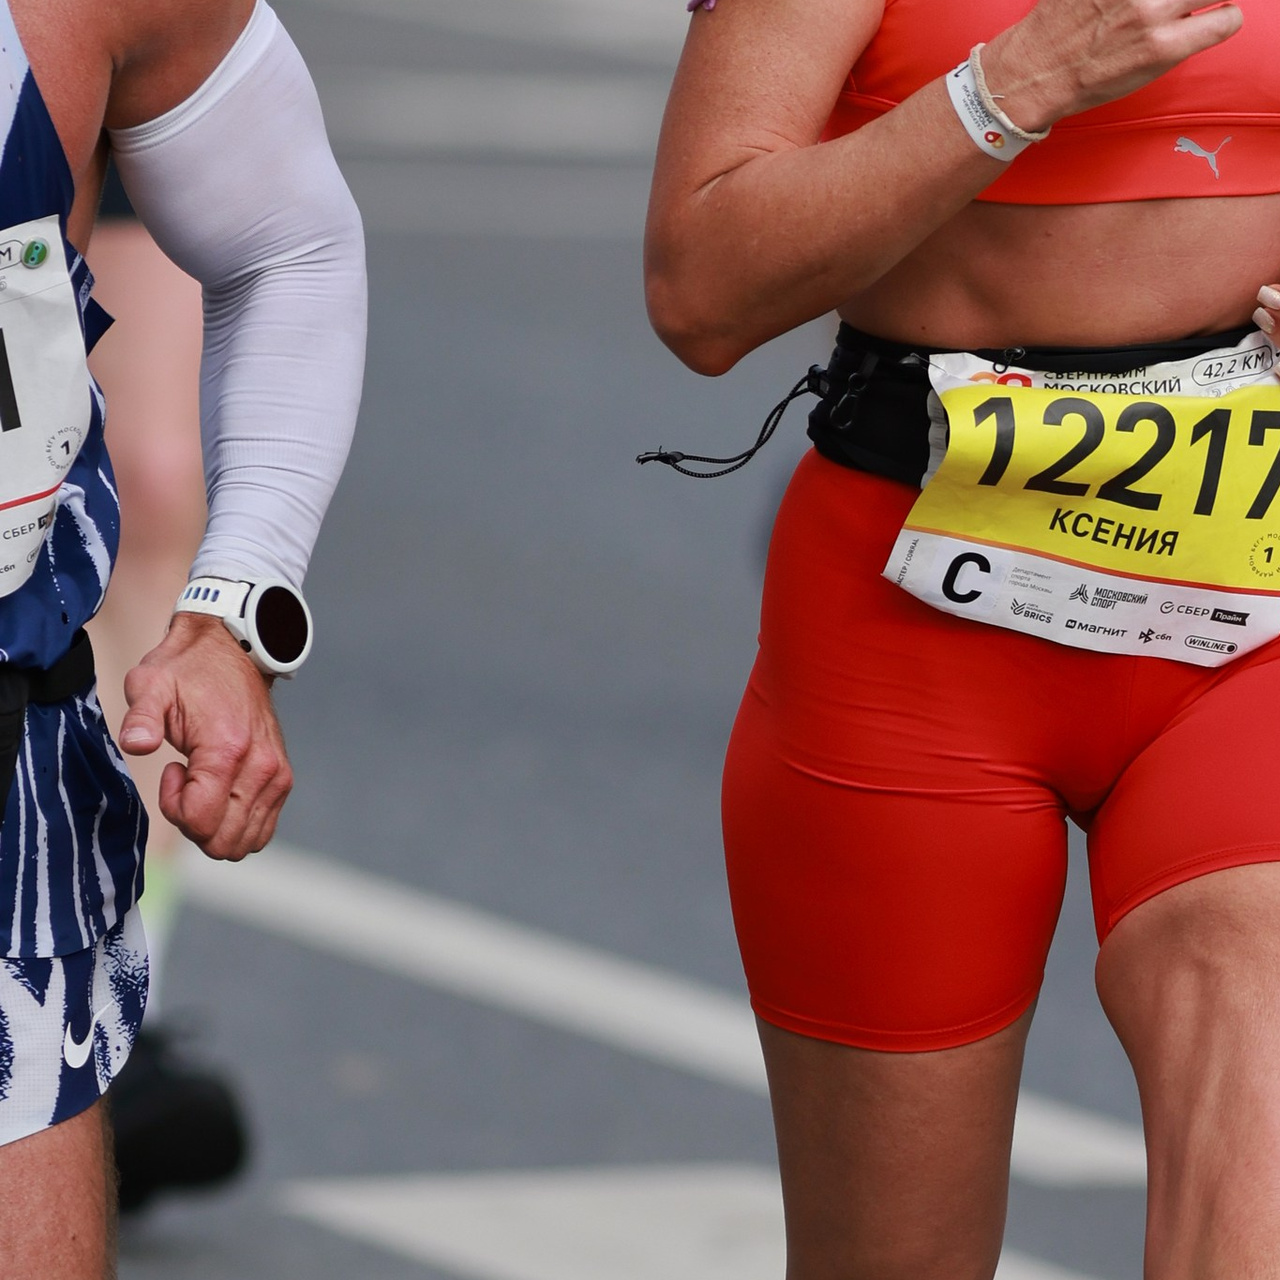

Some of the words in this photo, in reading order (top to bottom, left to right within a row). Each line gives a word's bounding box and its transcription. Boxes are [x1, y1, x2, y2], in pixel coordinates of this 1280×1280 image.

[1203, 359, 1237, 379] 42,2
[1044, 375, 1181, 396] МОСКОВСКИЙ
[60, 440, 70, 455] 1
[2, 522, 36, 540] СБЕР
[1048, 507, 1180, 557] КСЕНИЯ
[905, 538, 920, 562] CORRAL
[1250, 536, 1264, 552] БЕГУ
[1263, 546, 1274, 564] 1
[1248, 555, 1274, 577] МАРАФОН
[1090, 596, 1118, 610] СПОРТ
[1094, 587, 1149, 605] МОСКОВСКИЙ
[1023, 609, 1053, 624] BRICS
[1176, 604, 1210, 618] СБЕР
[1214, 610, 1243, 623] Прайм
[1077, 622, 1128, 638] магнит
[1155, 633, 1173, 641] сбп
[1188, 637, 1227, 652] WINLINE
